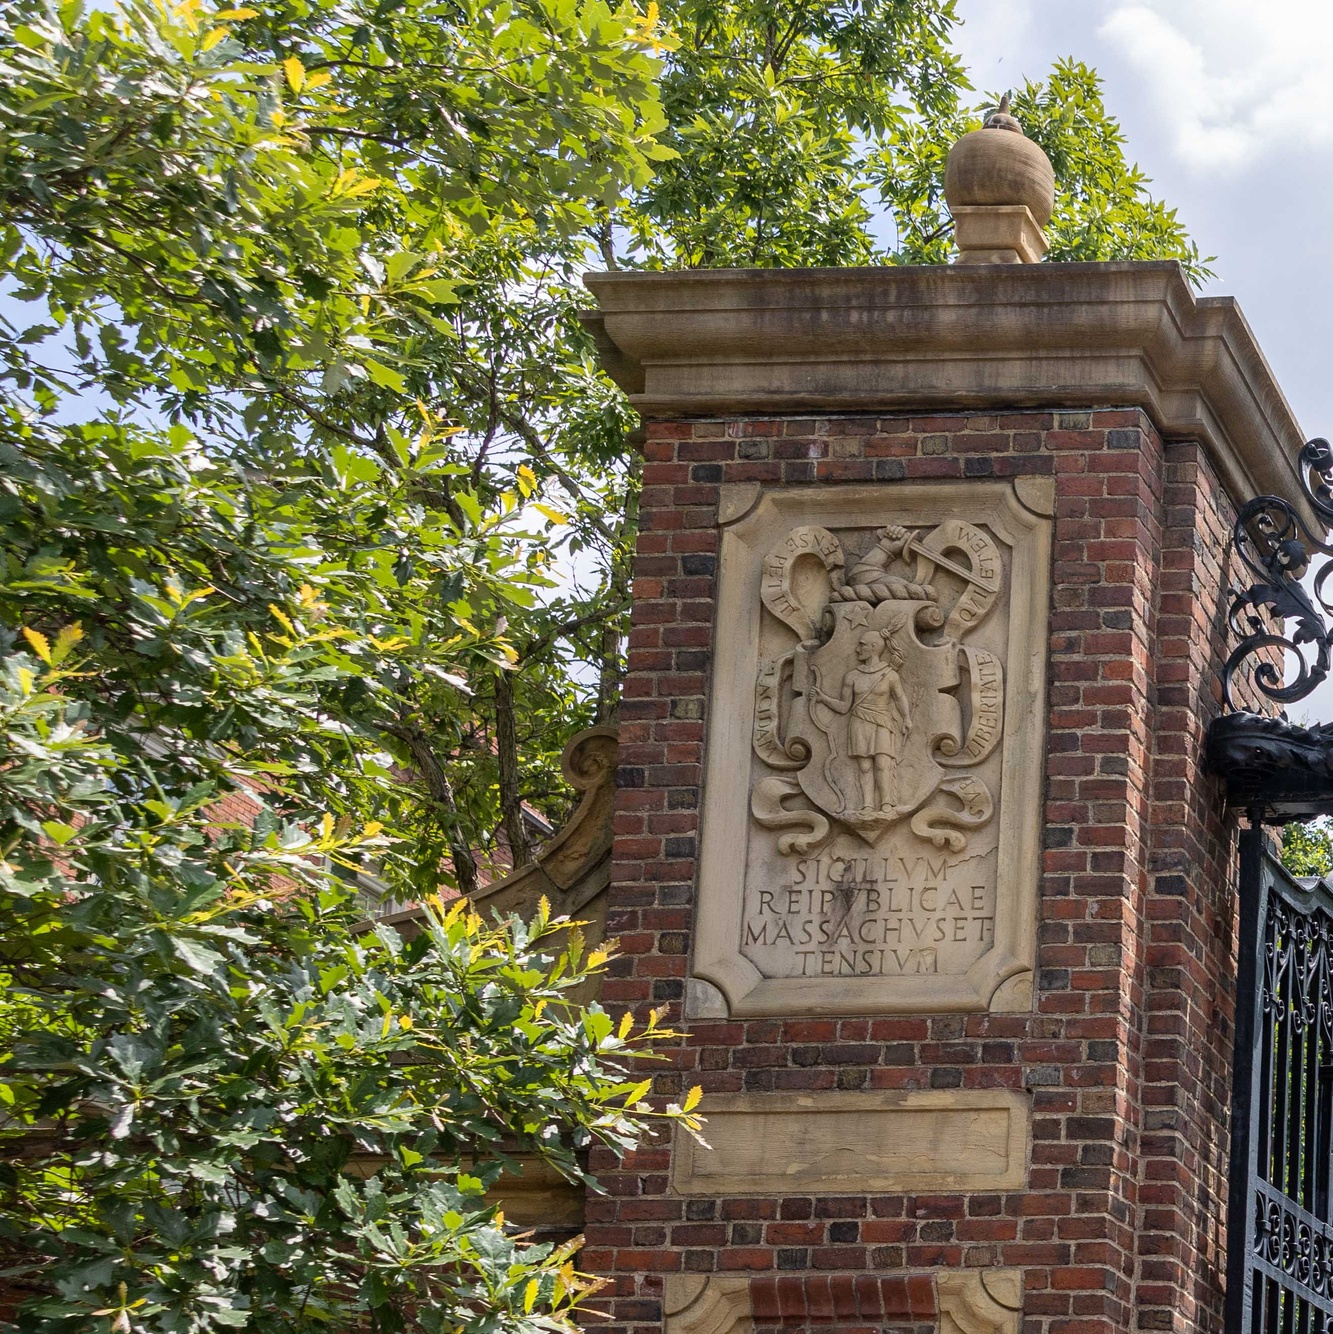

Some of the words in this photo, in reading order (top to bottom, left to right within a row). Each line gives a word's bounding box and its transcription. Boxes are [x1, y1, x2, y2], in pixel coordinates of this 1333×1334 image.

[756, 660, 777, 758] LACIDAM
[793, 857, 948, 884] SIGILLVM
[758, 886, 986, 915] REIPVBLICAE
[795, 948, 939, 975] TENSIVM
